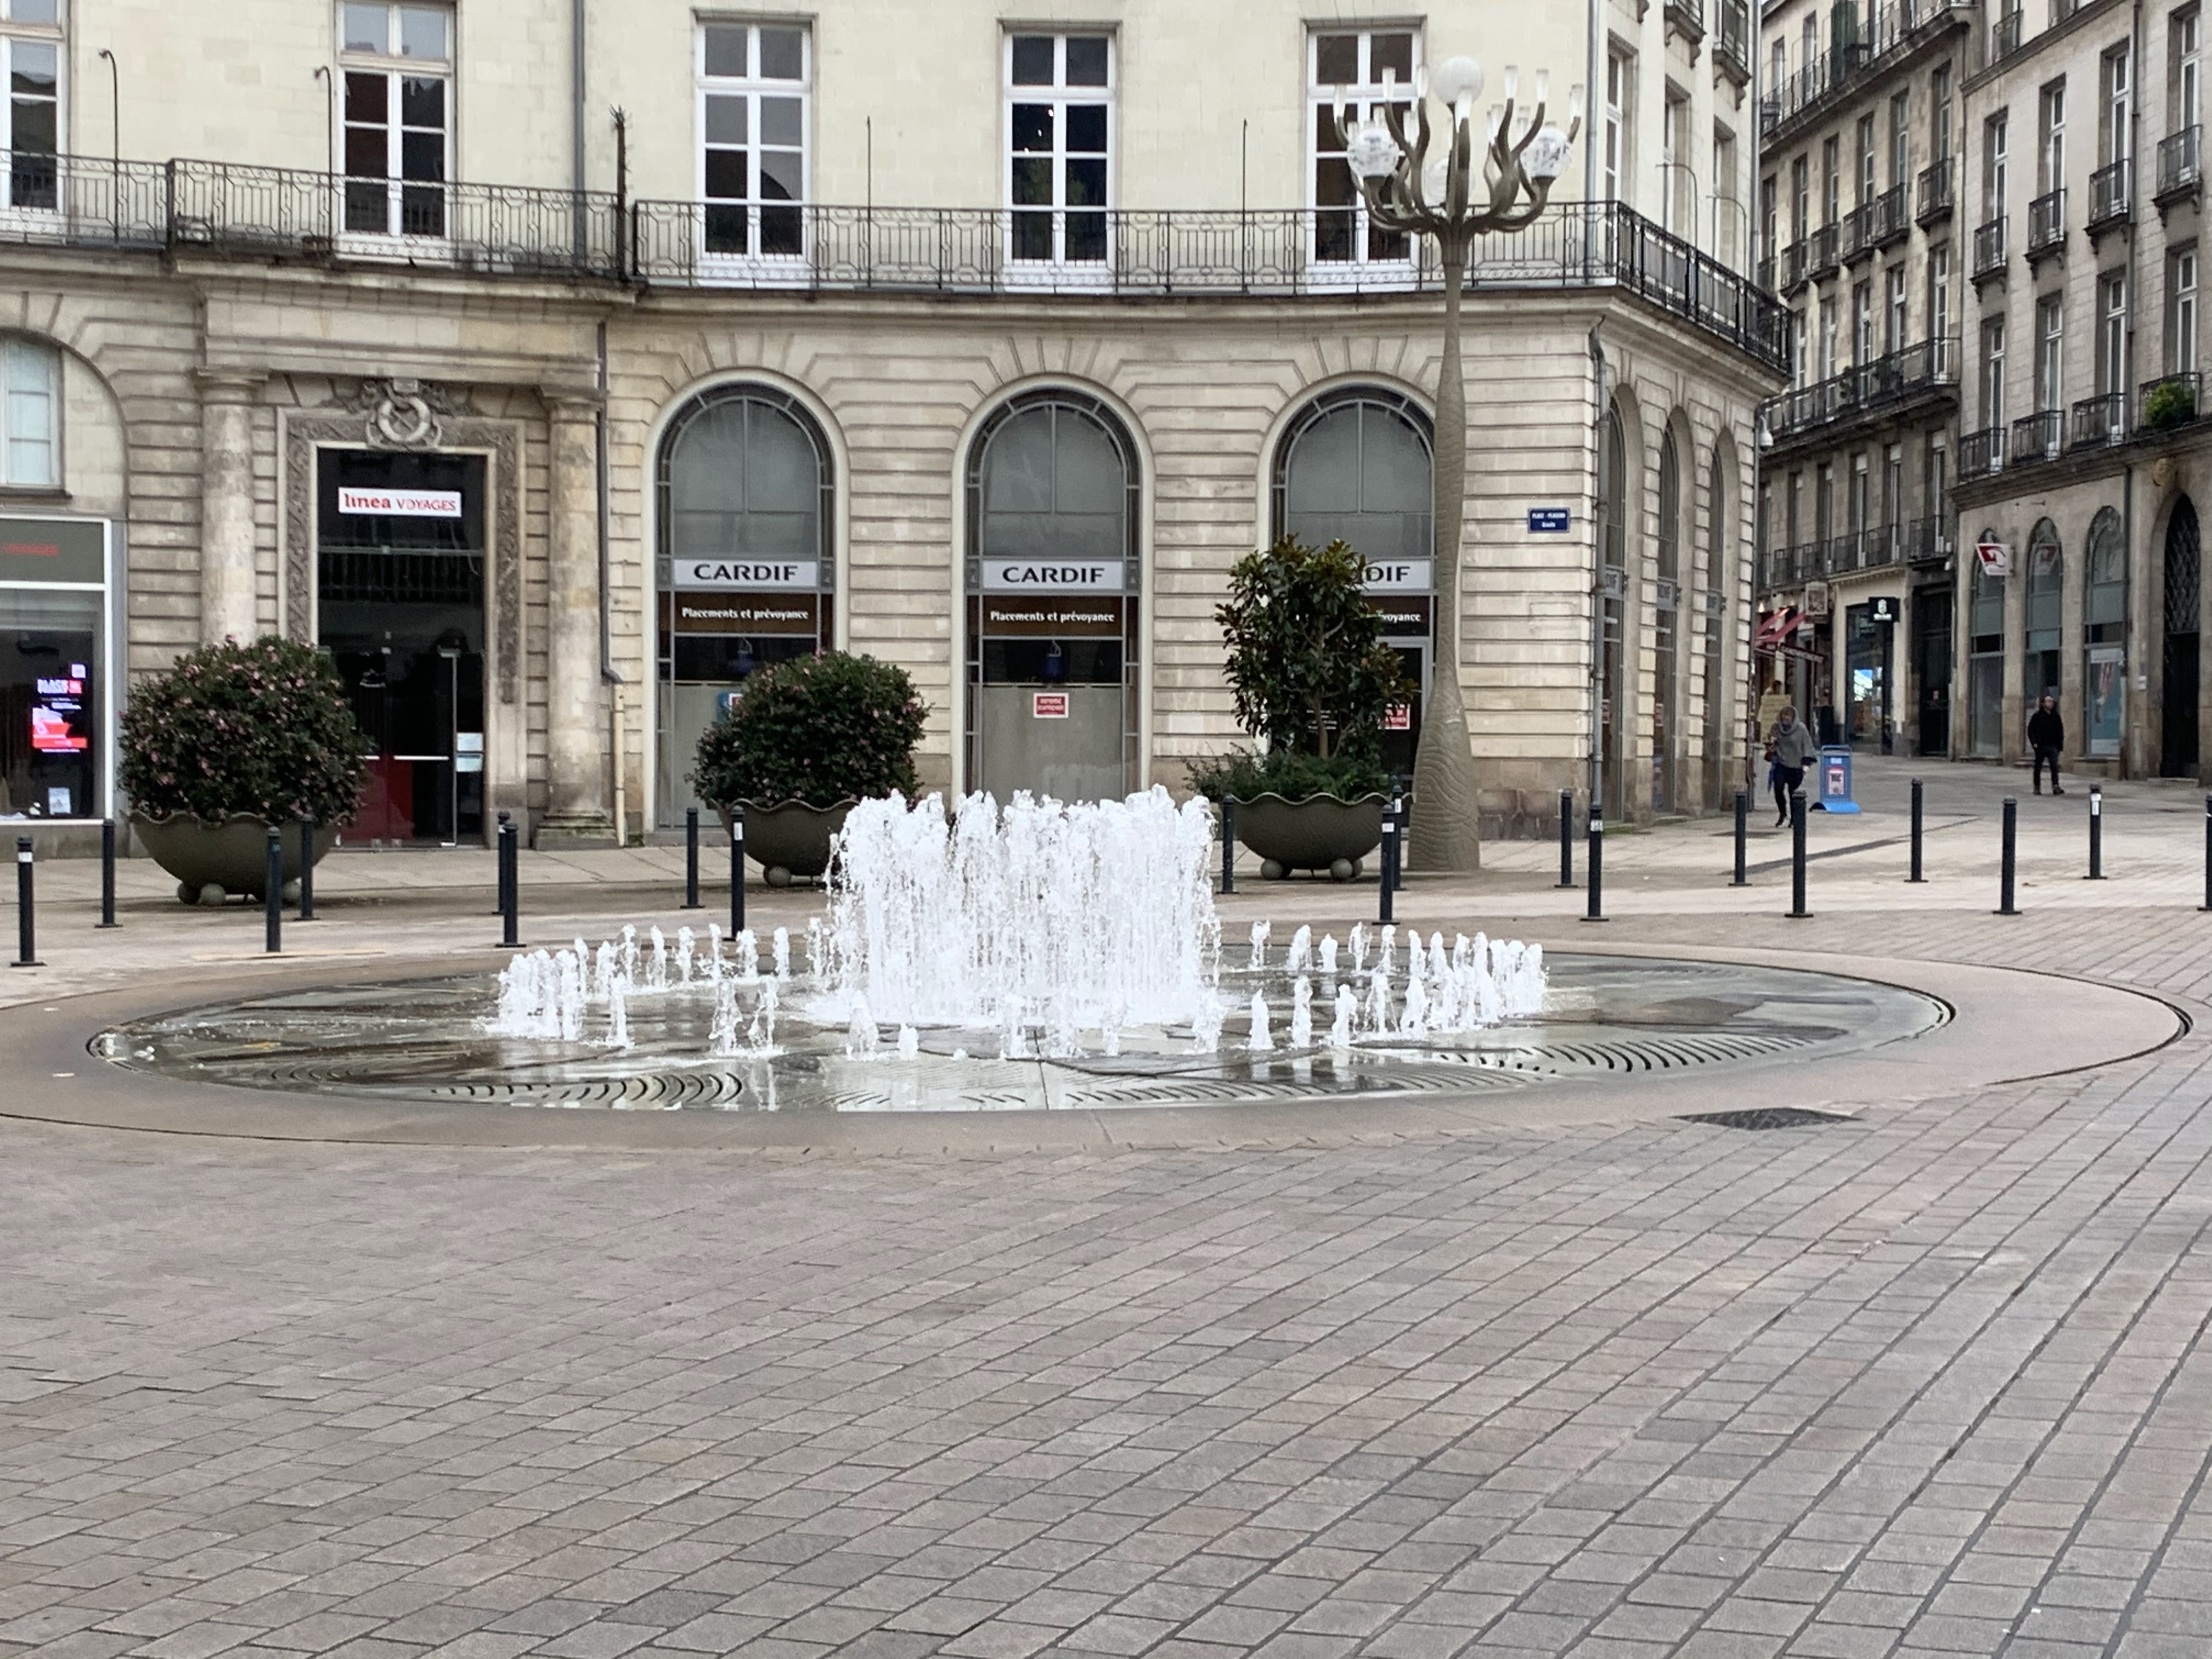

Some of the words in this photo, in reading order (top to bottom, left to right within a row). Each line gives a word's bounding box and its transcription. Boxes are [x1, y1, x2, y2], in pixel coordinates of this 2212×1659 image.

[344, 494, 391, 509] linea
[396, 498, 456, 511] VOYAGES
[693, 563, 798, 581] CARDIF
[1002, 566, 1105, 583] CARDIF
[1366, 566, 1410, 582] DIF
[681, 607, 738, 618] Placements
[741, 609, 752, 619] et
[753, 608, 809, 621] prévoyance
[990, 611, 1045, 622] Placements
[1047, 612, 1058, 622] et
[1060, 610, 1115, 624] prévoyance
[1382, 613, 1420, 623] voyance
